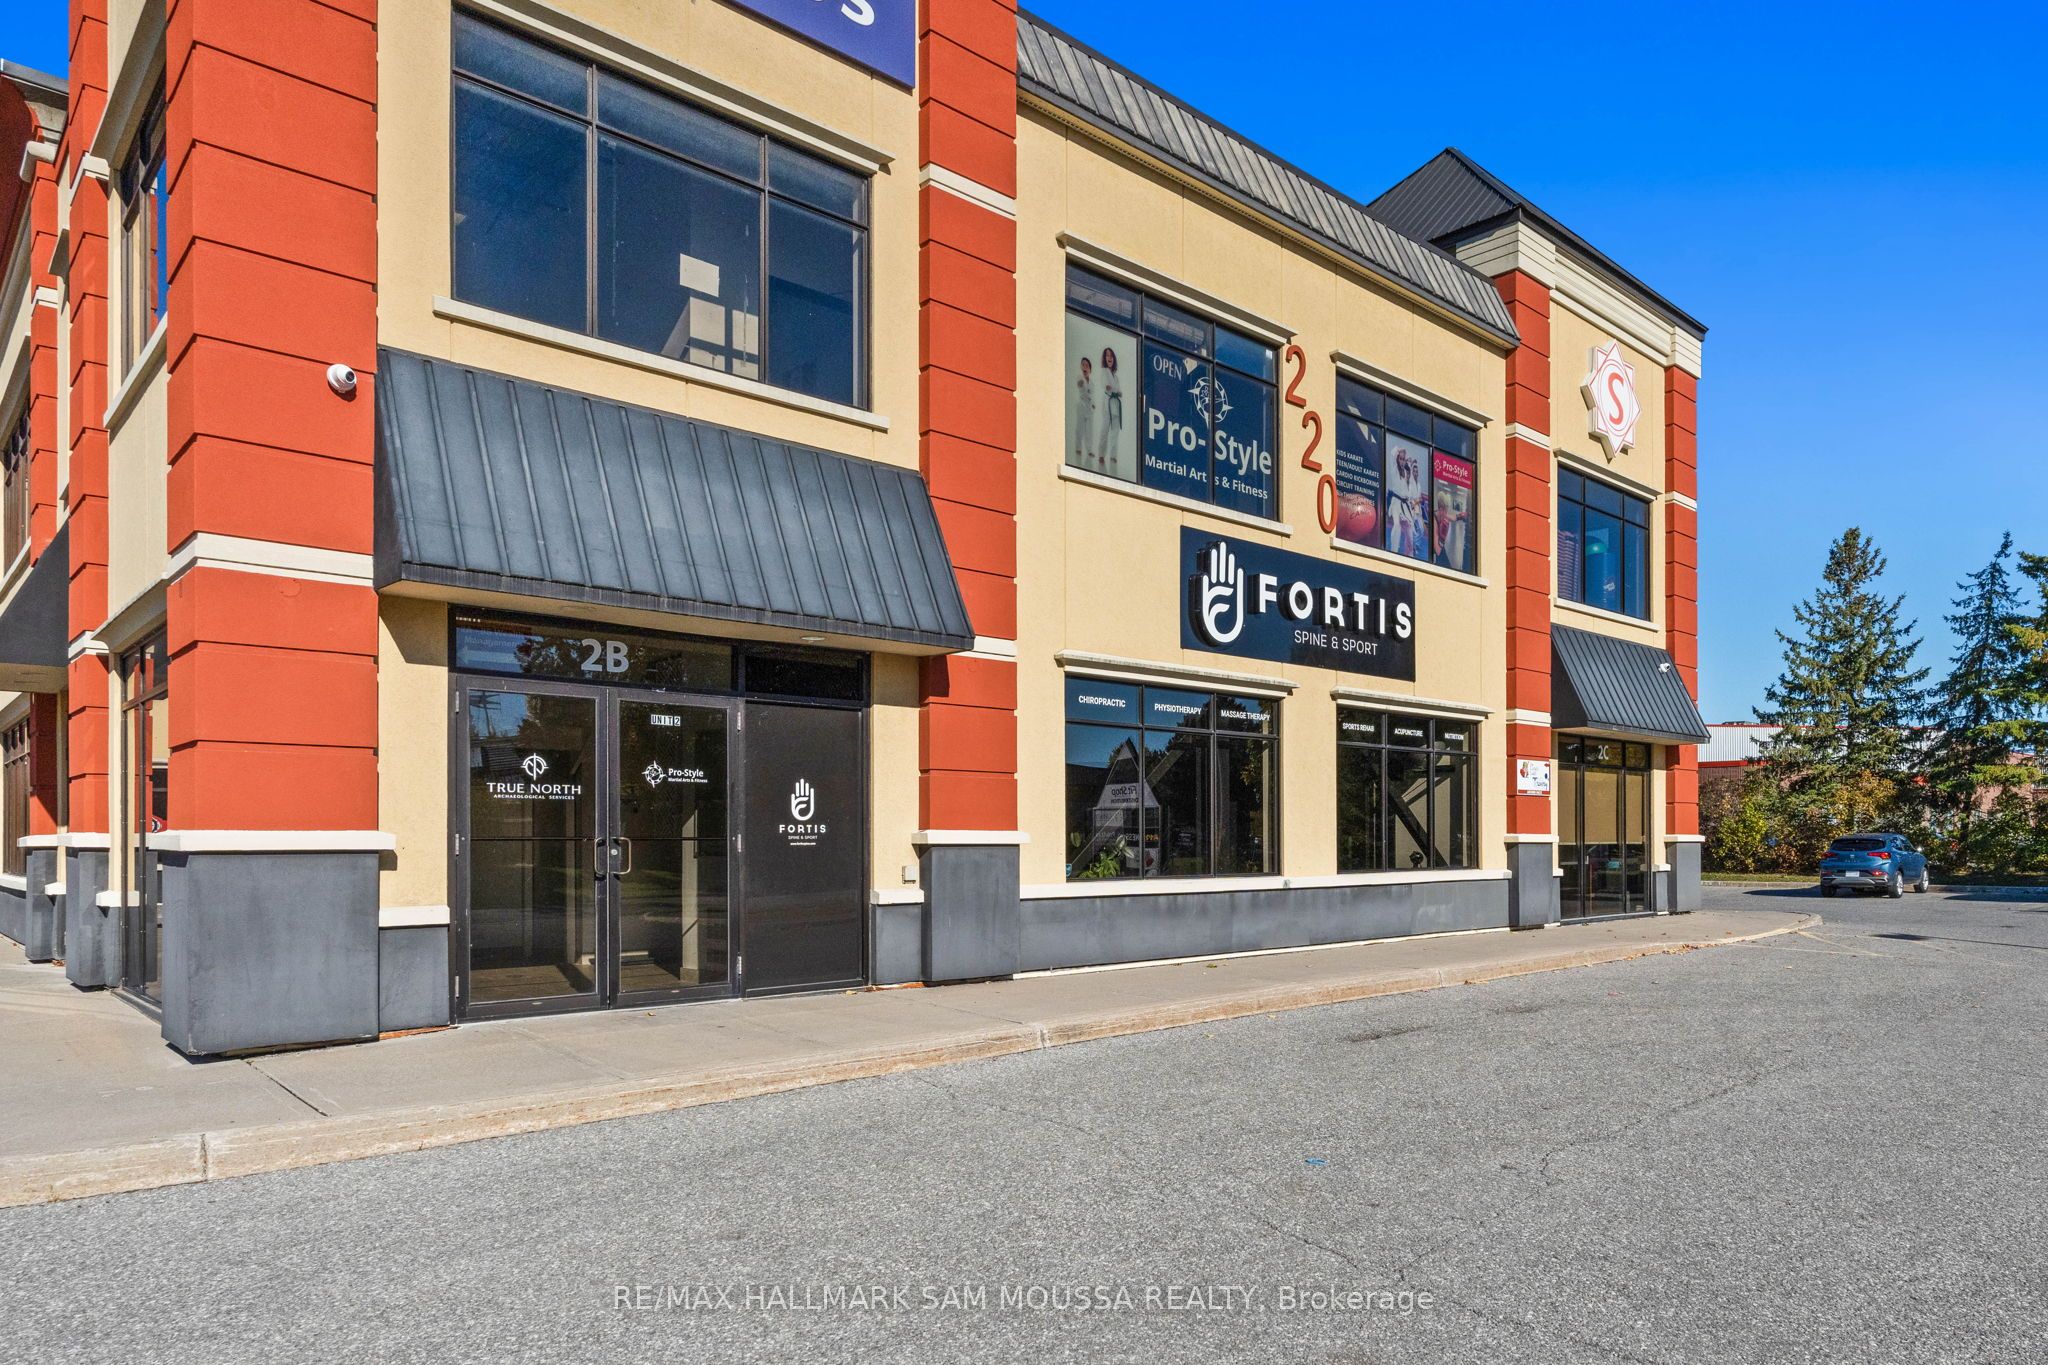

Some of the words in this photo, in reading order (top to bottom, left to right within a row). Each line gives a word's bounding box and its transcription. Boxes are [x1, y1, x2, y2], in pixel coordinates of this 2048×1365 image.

[1153, 354, 1182, 381] OPEN
[1607, 372, 1624, 425] S
[1347, 452, 1363, 464] KARATE
[1363, 468, 1380, 479] KARATE
[1442, 460, 1469, 477] Pro-Style
[1145, 454, 1187, 477] Martial
[1221, 477, 1230, 489] &
[1232, 479, 1268, 499] Fitness
[1336, 469, 1353, 480] CARDIO
[1353, 475, 1380, 488] KICKBOXING
[1336, 480, 1354, 490] CIRCUIT
[1354, 485, 1375, 497] TRAINING
[1259, 573, 1412, 639] FORTIS
[1294, 630, 1327, 648] SPINE
[1331, 636, 1339, 649] &
[1342, 638, 1378, 656] SPORT
[581, 638, 630, 673] 2B
[1078, 695, 1126, 708] CHIROPRACTIC
[1154, 703, 1202, 715] PHYSIOTHERAPY
[1220, 709, 1247, 720] MASSAGE
[1247, 712, 1271, 722] THERAPY
[651, 714, 673, 726] UNIT
[674, 716, 681, 727] 2
[1342, 722, 1360, 731] SPORTS
[1360, 724, 1375, 732] REHAB
[1394, 728, 1423, 737] ACUPUNCTURE
[1444, 732, 1464, 740] NUTRITION
[1598, 745, 1609, 760] 2C
[668, 768, 704, 779] Pro-Style
[486, 782, 525, 794] TRUE
[530, 784, 581, 795] NORTH
[779, 824, 826, 833] FORTIS
